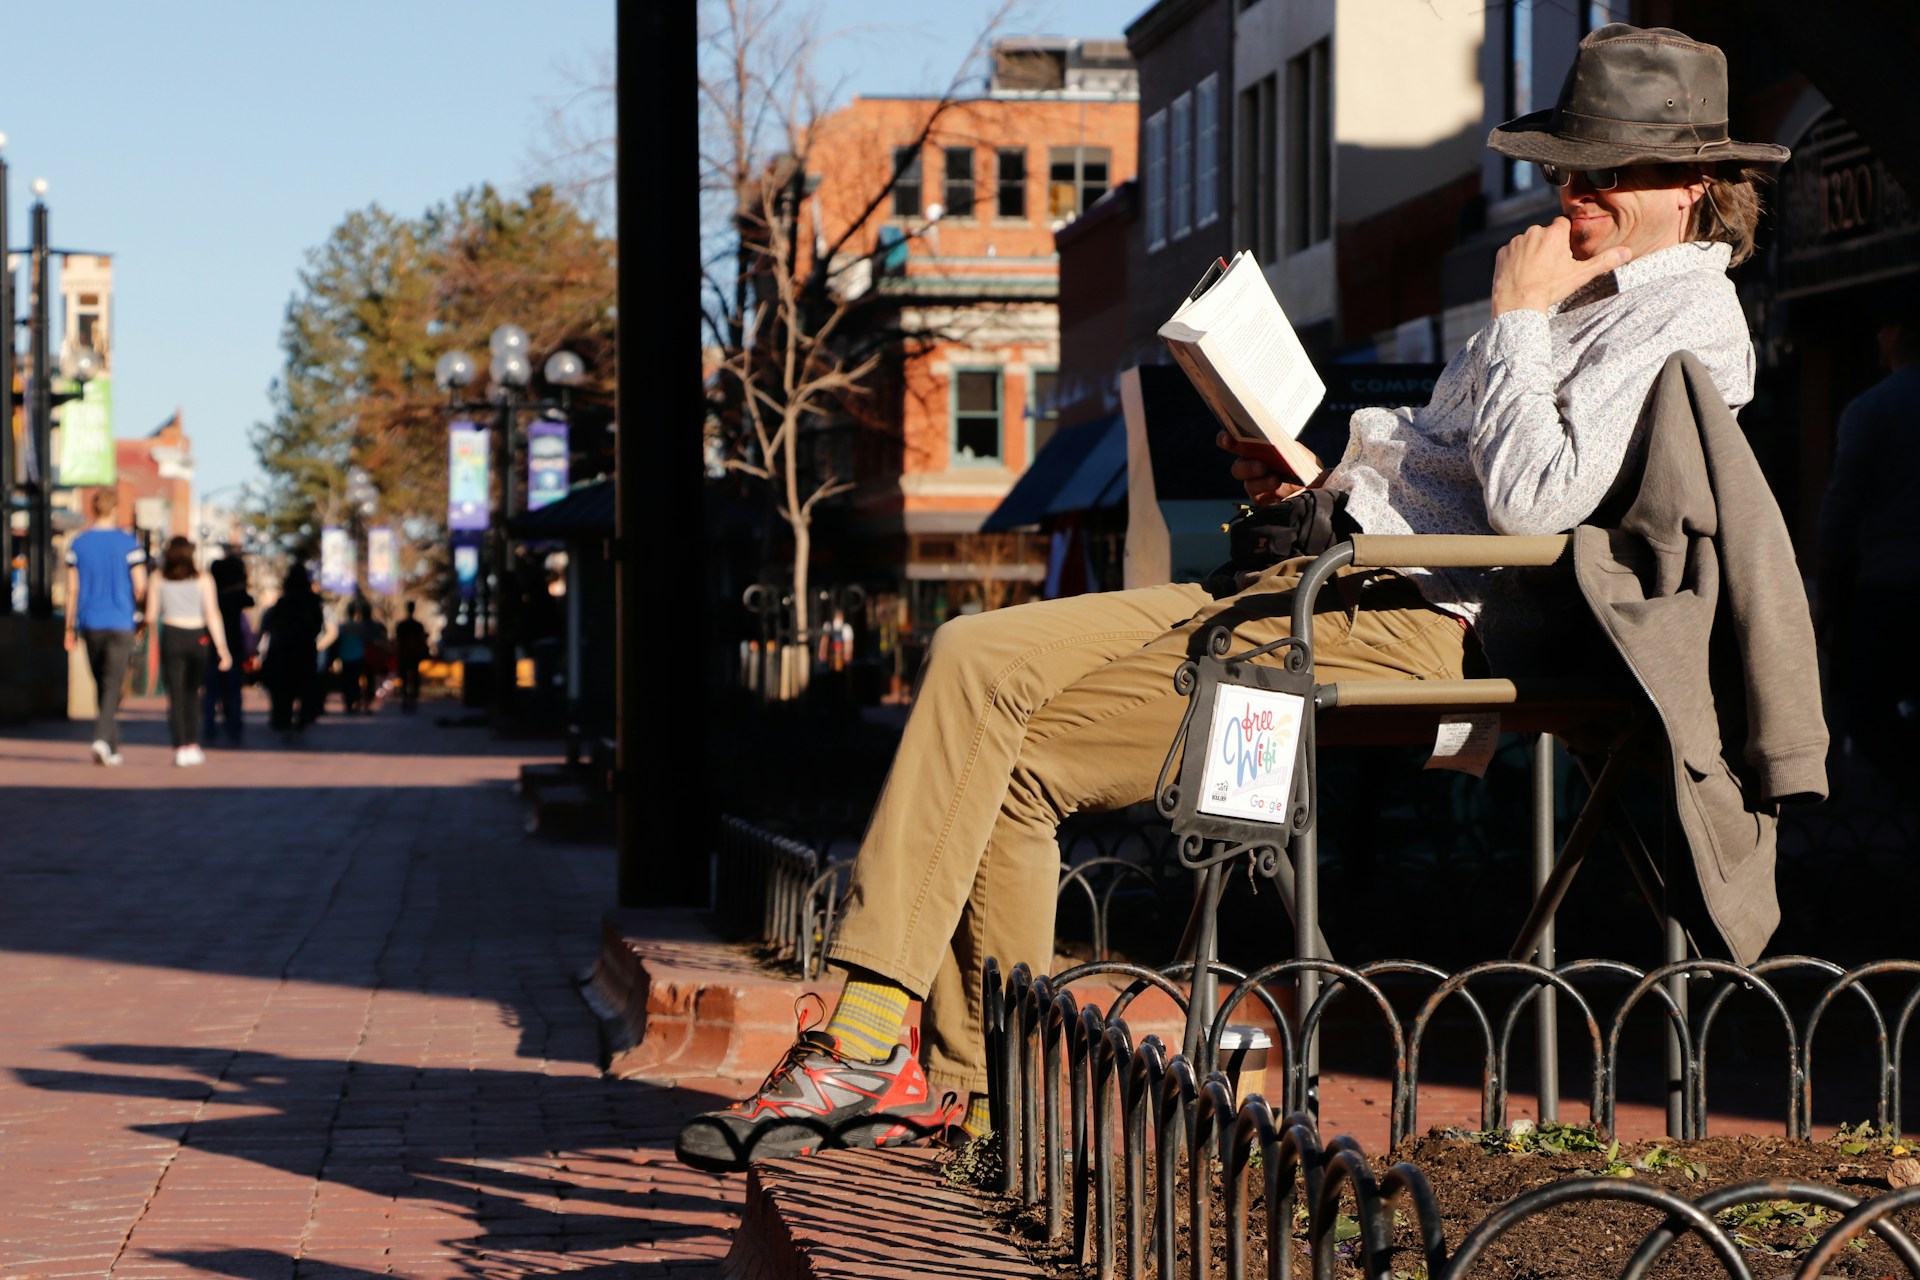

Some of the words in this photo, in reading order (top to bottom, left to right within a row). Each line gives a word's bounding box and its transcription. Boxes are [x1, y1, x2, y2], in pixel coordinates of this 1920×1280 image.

[1242, 703, 1274, 741] free
[1224, 717, 1277, 787] Wifi
[1250, 794, 1282, 814] Gogle
